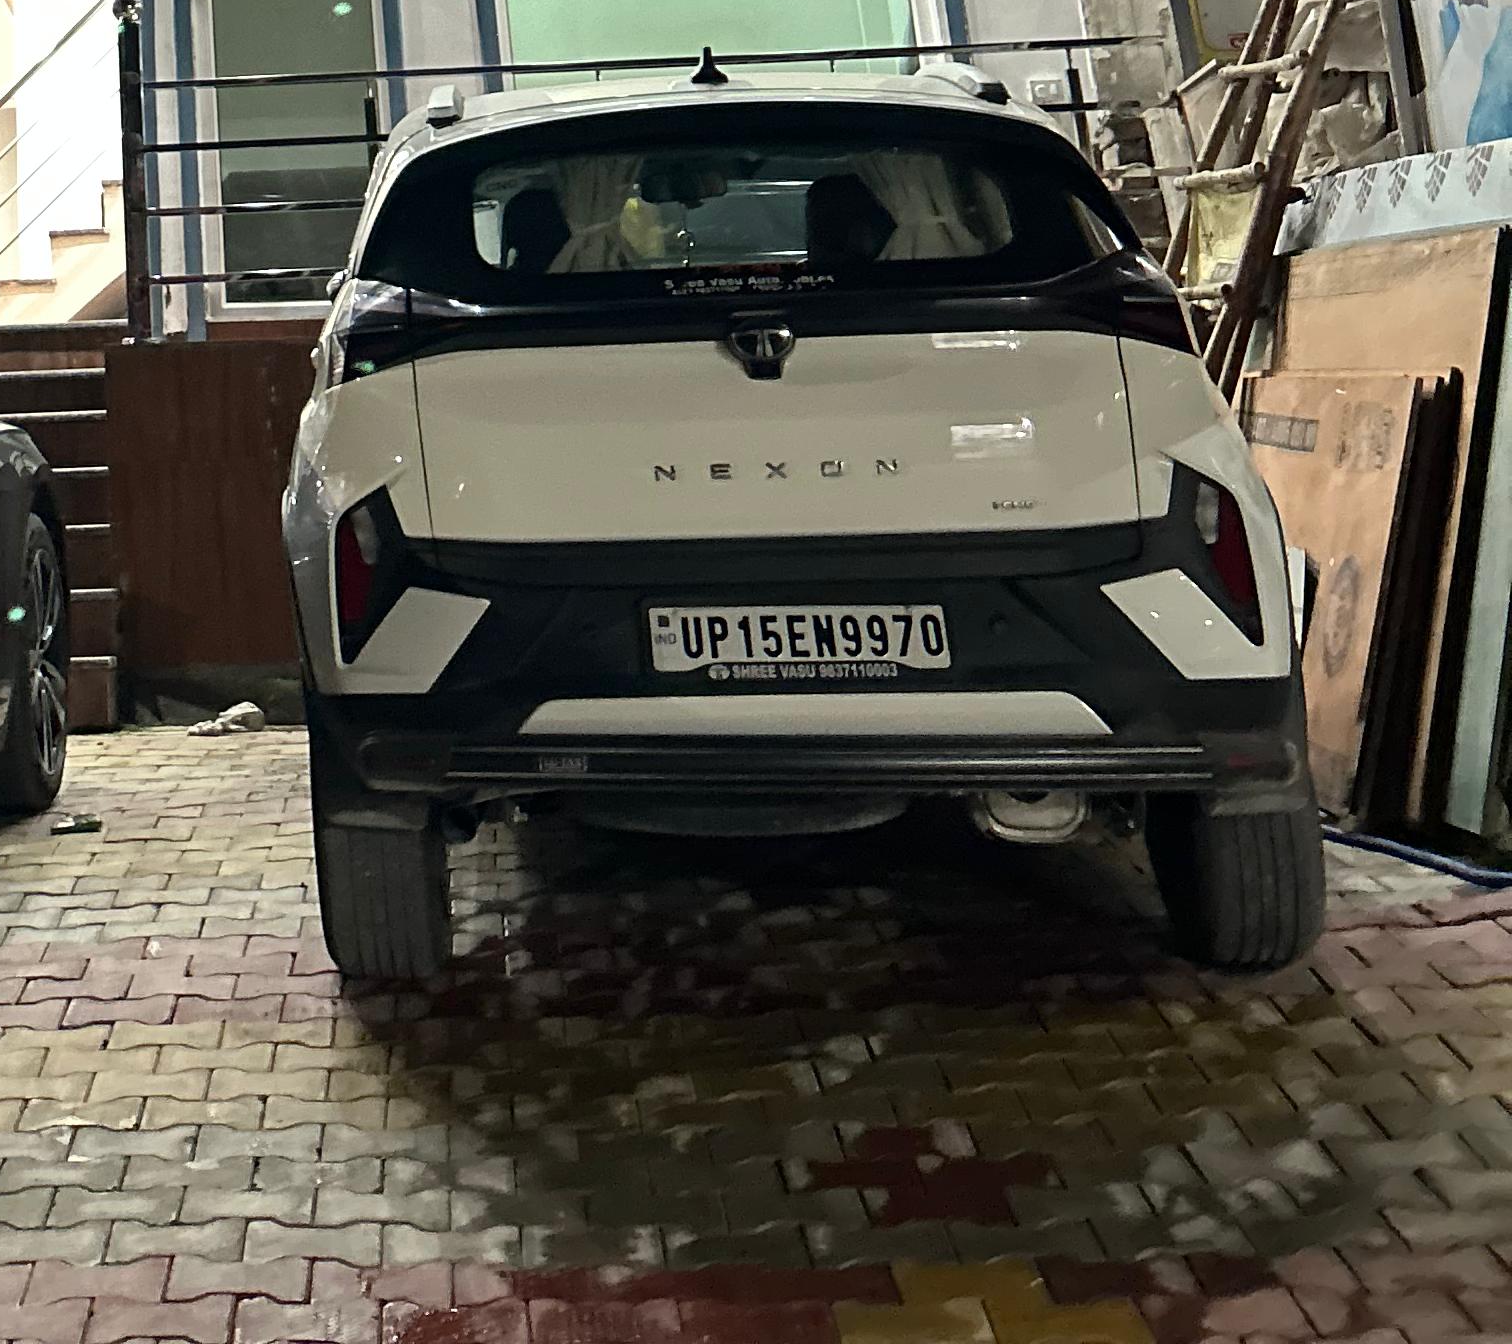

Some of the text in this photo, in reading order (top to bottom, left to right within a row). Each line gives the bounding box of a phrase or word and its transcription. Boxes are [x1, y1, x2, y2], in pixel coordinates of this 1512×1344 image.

[654, 458, 898, 481] NEXON
[681, 613, 945, 659] UP15EN9970
[731, 663, 777, 679] SHREE
[779, 663, 816, 679] VASU
